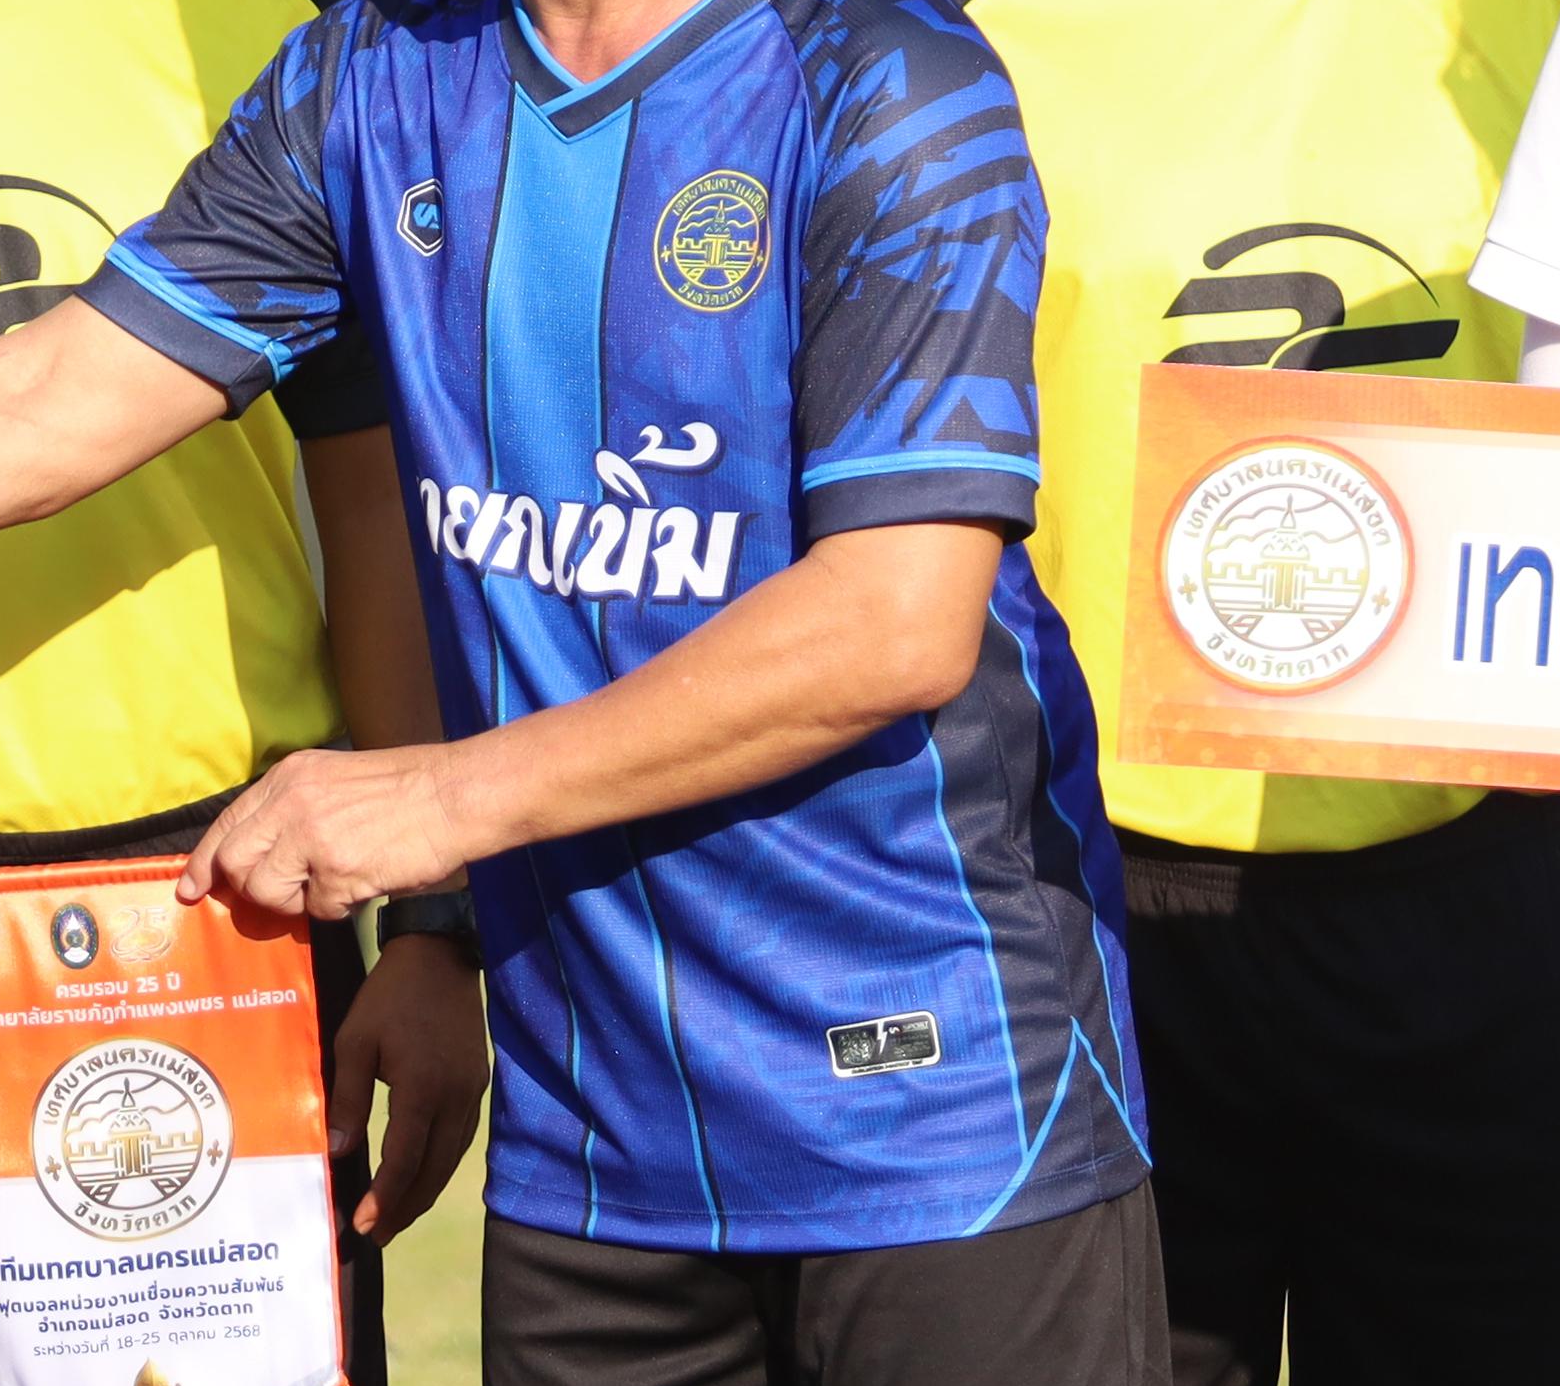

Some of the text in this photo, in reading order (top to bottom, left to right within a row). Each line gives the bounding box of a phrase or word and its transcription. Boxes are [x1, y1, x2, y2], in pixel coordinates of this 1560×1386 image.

[419, 420, 742, 598] ายกเบิ้ม
[55, 970, 181, 1000] ครบรอบ 25 ปี
[232, 986, 297, 1009] แม่สอด
[42, 1047, 217, 1126] เทศบาลนครแม่สอด
[0, 1239, 280, 1283] ทีมเทศบาลนครแม่สอด
[38, 1300, 254, 1333] อำเภอแม่สอด จังหวัดตาก
[33, 1324, 261, 1357] ระหว่างวันที่ 18-25 ตุลาคม 2568
